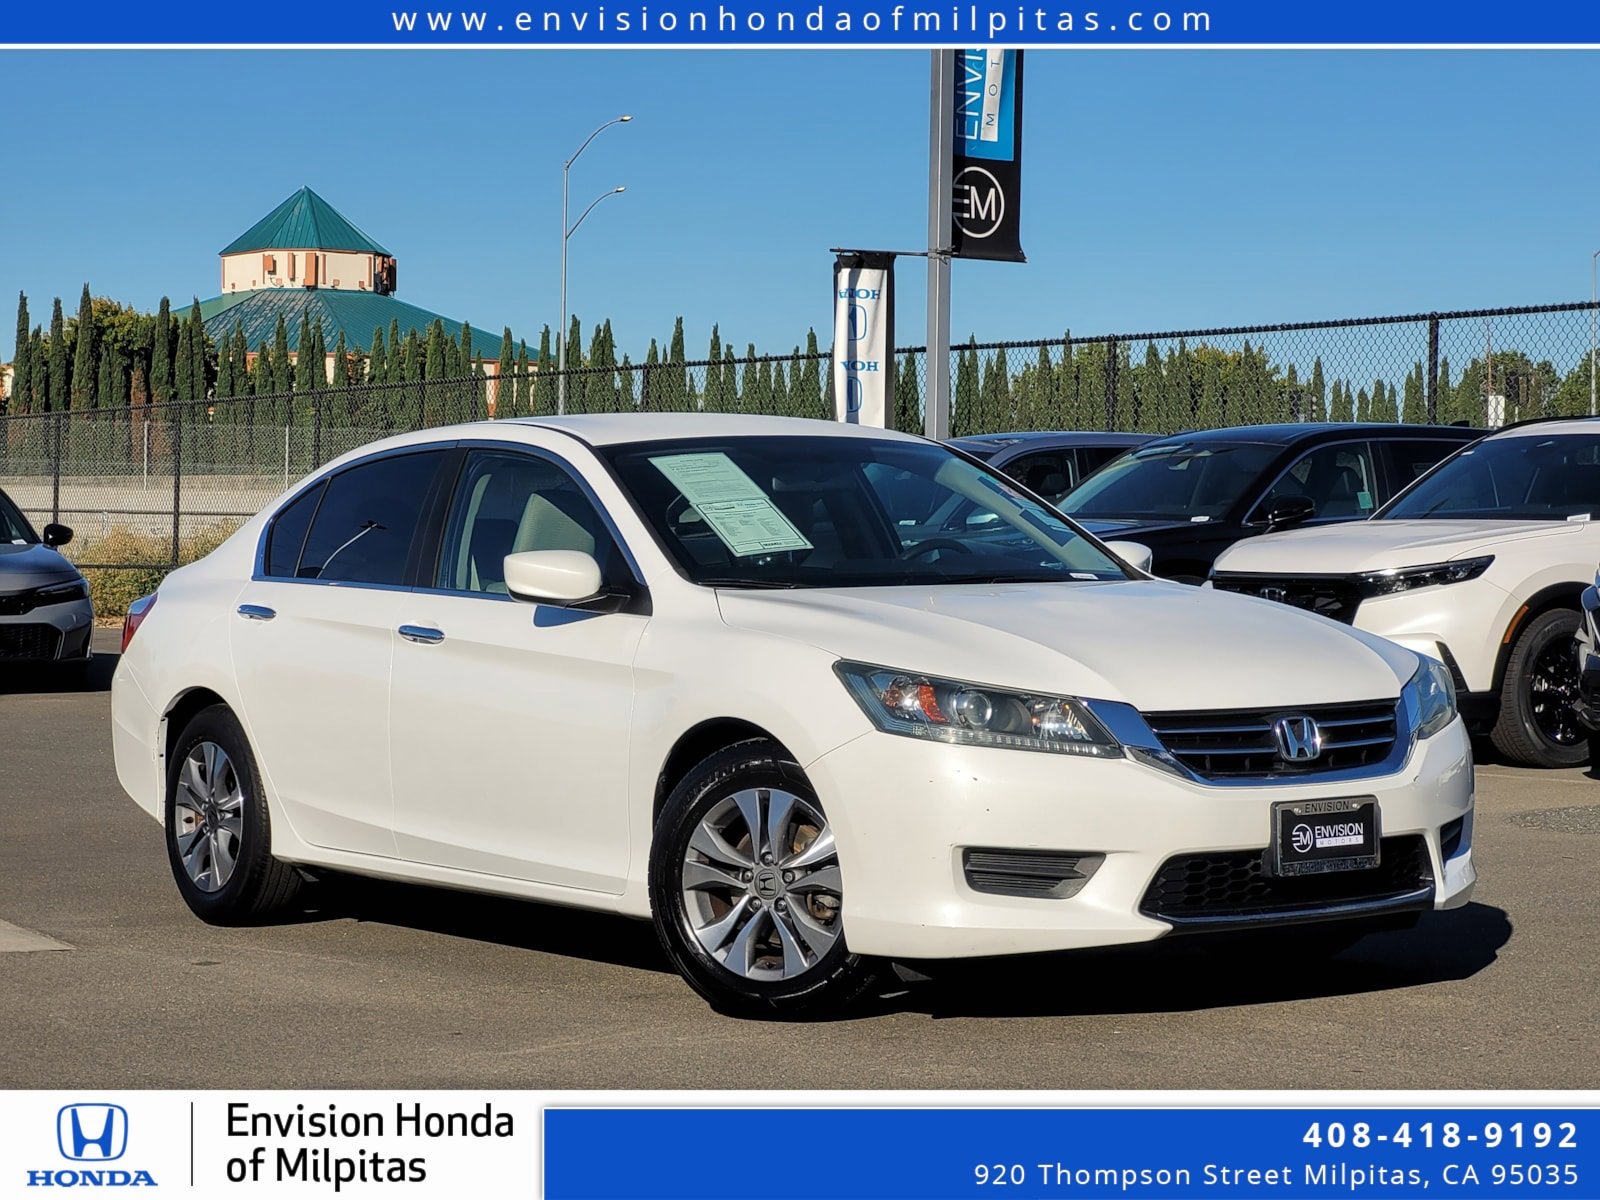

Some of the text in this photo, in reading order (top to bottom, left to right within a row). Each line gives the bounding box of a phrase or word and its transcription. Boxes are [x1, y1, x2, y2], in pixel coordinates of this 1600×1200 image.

[955, 49, 983, 140] ENVI
[1305, 801, 1350, 813] ENVISION
[1315, 823, 1363, 838] ENVISION
[1319, 838, 1360, 846] MOTORS
